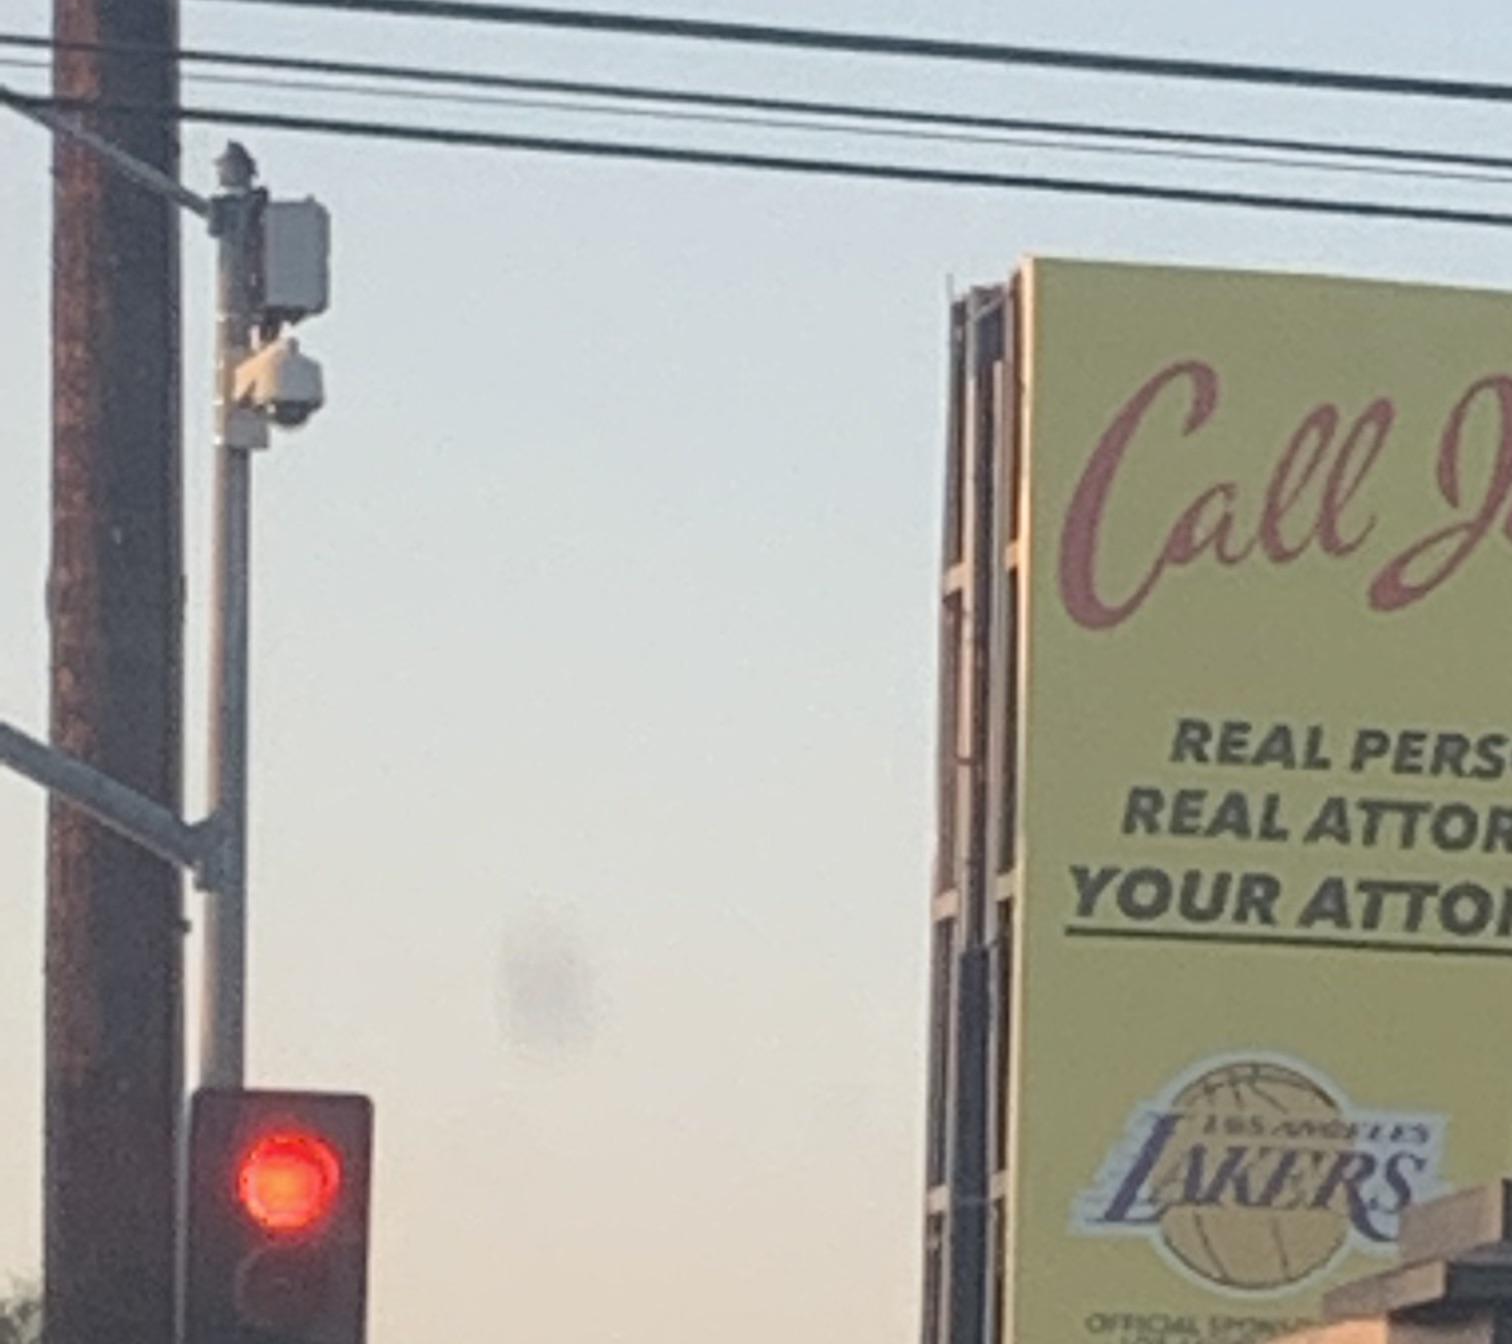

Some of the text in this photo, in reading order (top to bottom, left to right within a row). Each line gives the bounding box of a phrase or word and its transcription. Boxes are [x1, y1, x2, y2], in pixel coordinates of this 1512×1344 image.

[1059, 360, 1396, 632] Call
[1169, 718, 1331, 771] REAL
[1120, 785, 1288, 843] REAL
[1067, 864, 1282, 927] YOUR
[1084, 1110, 1430, 1244] LAKERS
